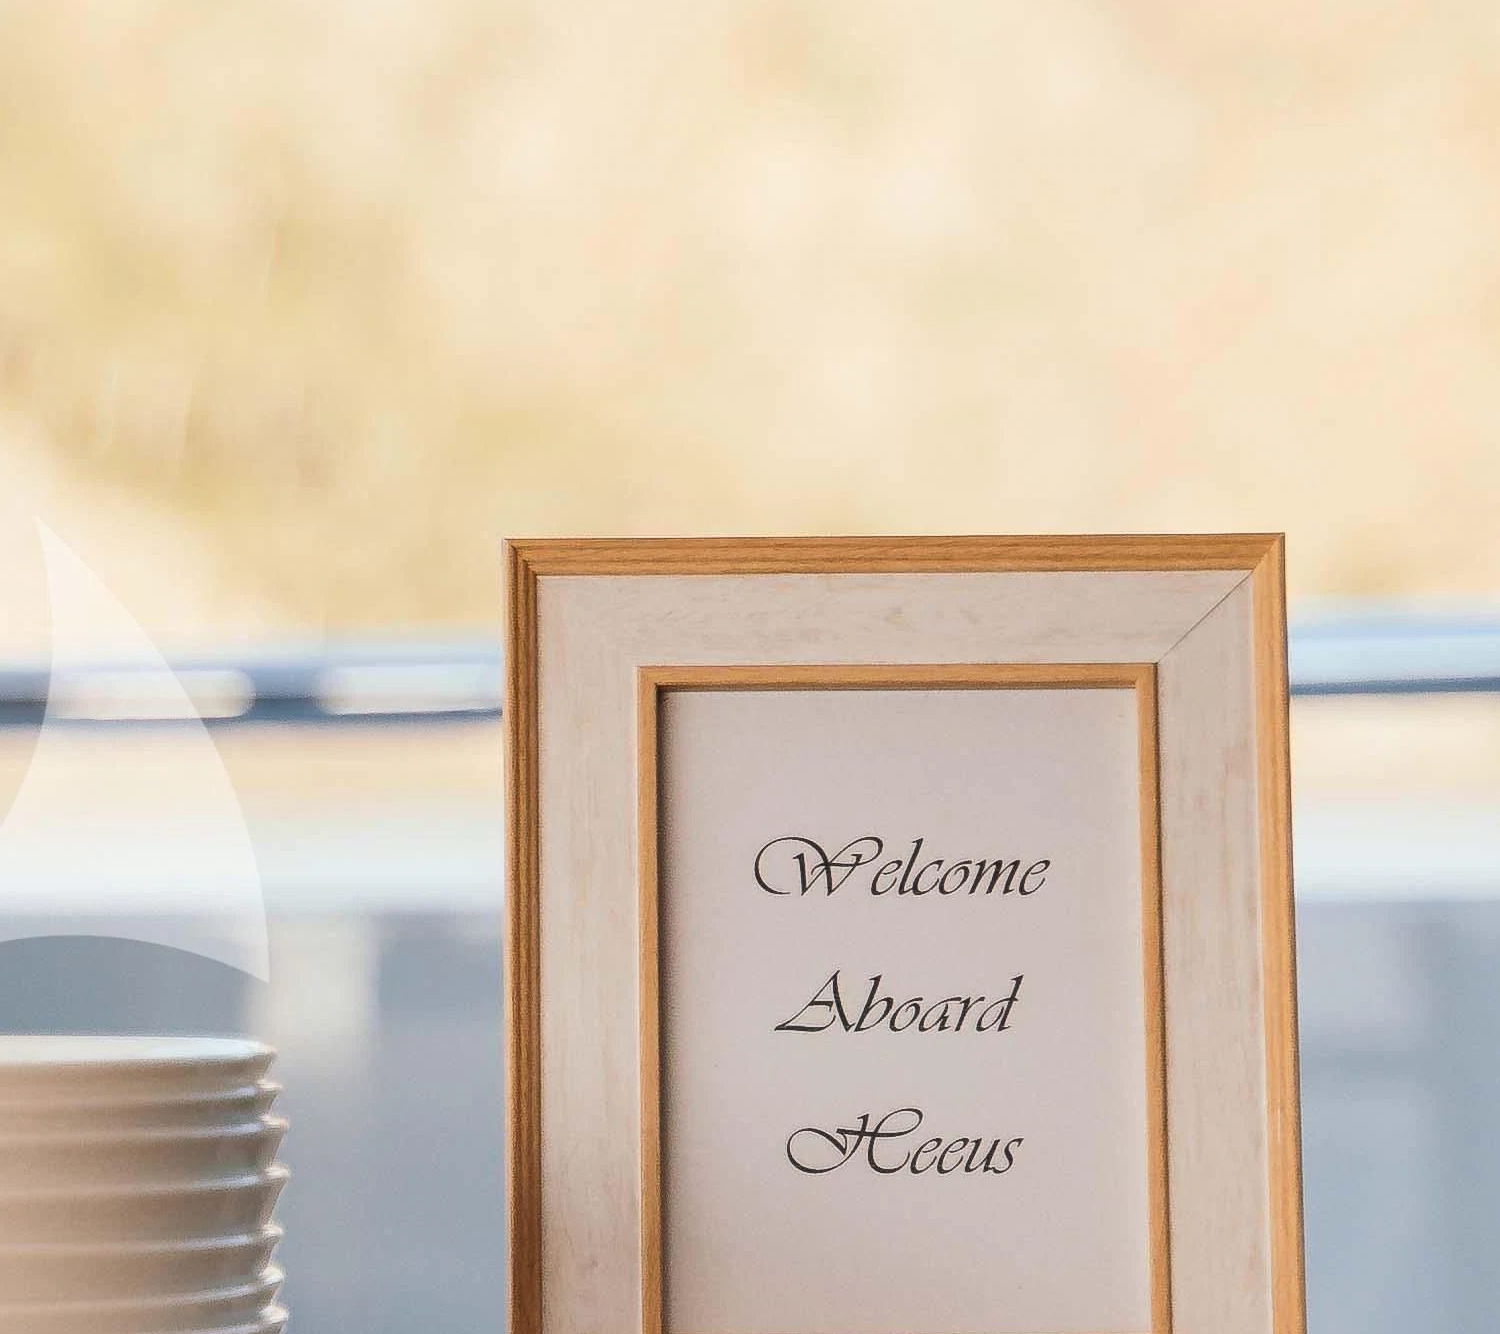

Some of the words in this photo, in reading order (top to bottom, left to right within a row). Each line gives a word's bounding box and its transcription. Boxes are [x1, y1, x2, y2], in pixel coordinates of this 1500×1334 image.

[753, 835, 1051, 897] Welcome
[773, 969, 1024, 1033] Aboard
[786, 1107, 1025, 1175] Heeus
